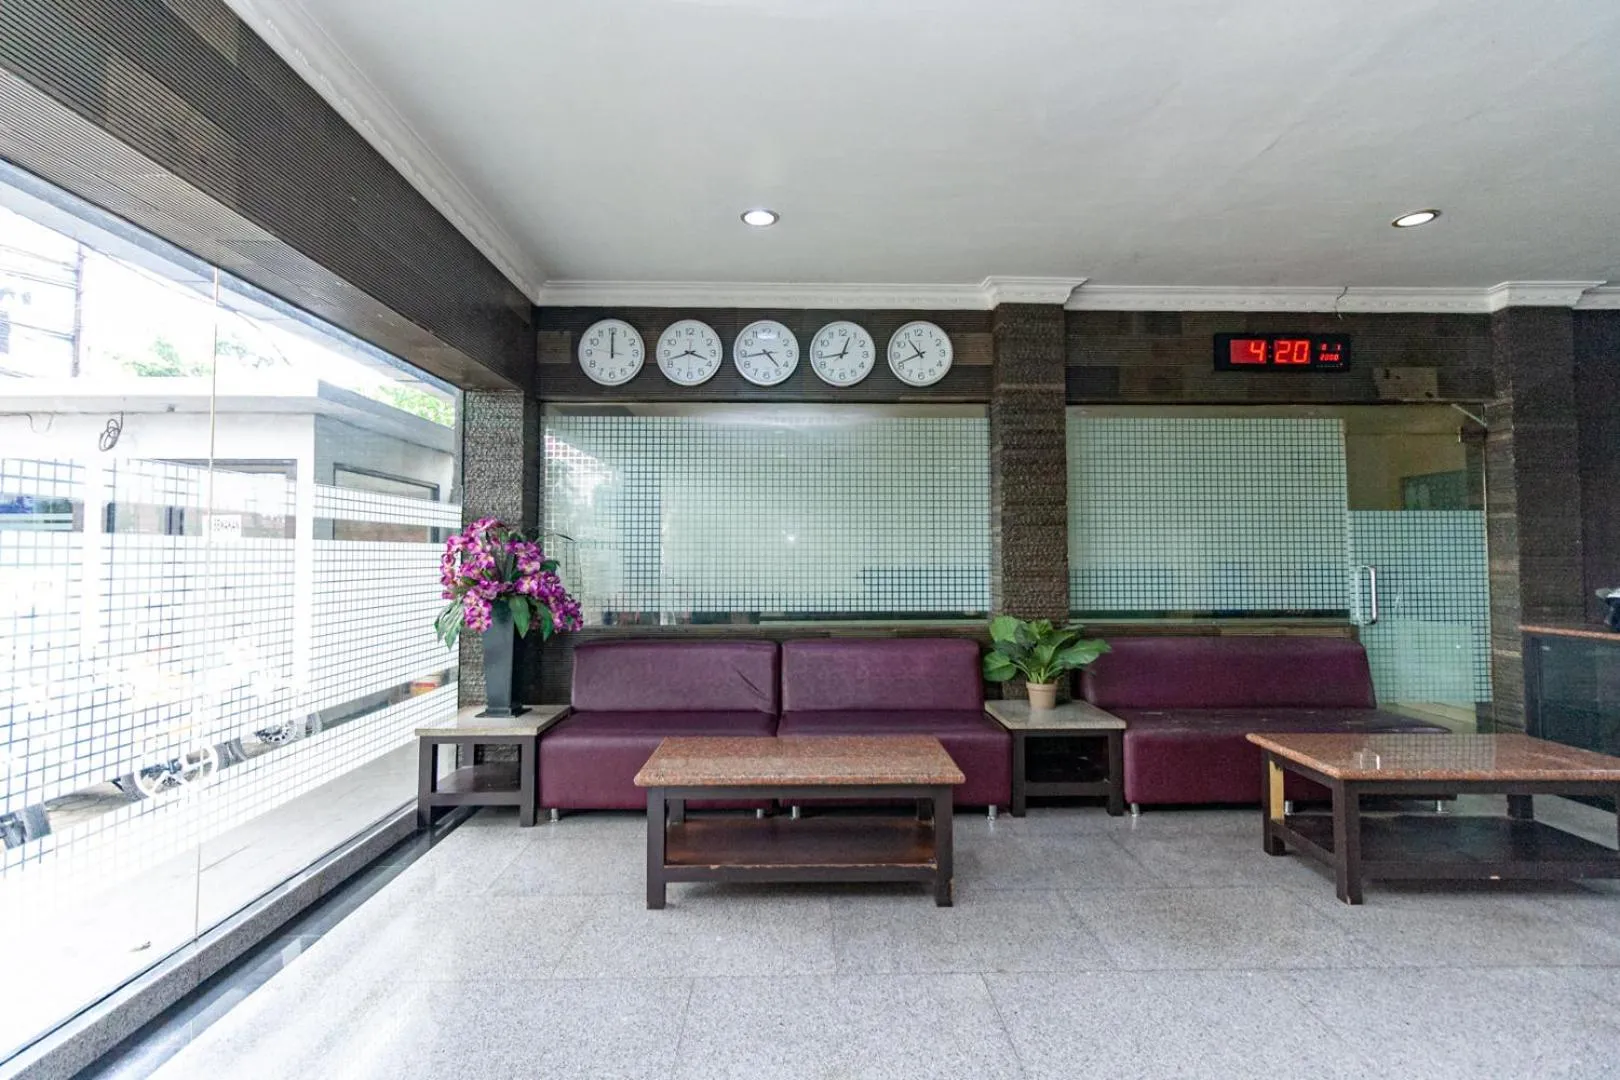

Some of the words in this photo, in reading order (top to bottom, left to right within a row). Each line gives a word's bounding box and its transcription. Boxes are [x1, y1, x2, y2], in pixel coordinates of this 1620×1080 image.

[753, 330, 758, 338] 11
[839, 328, 847, 336] 12
[1249, 340, 1309, 362] 4:20
